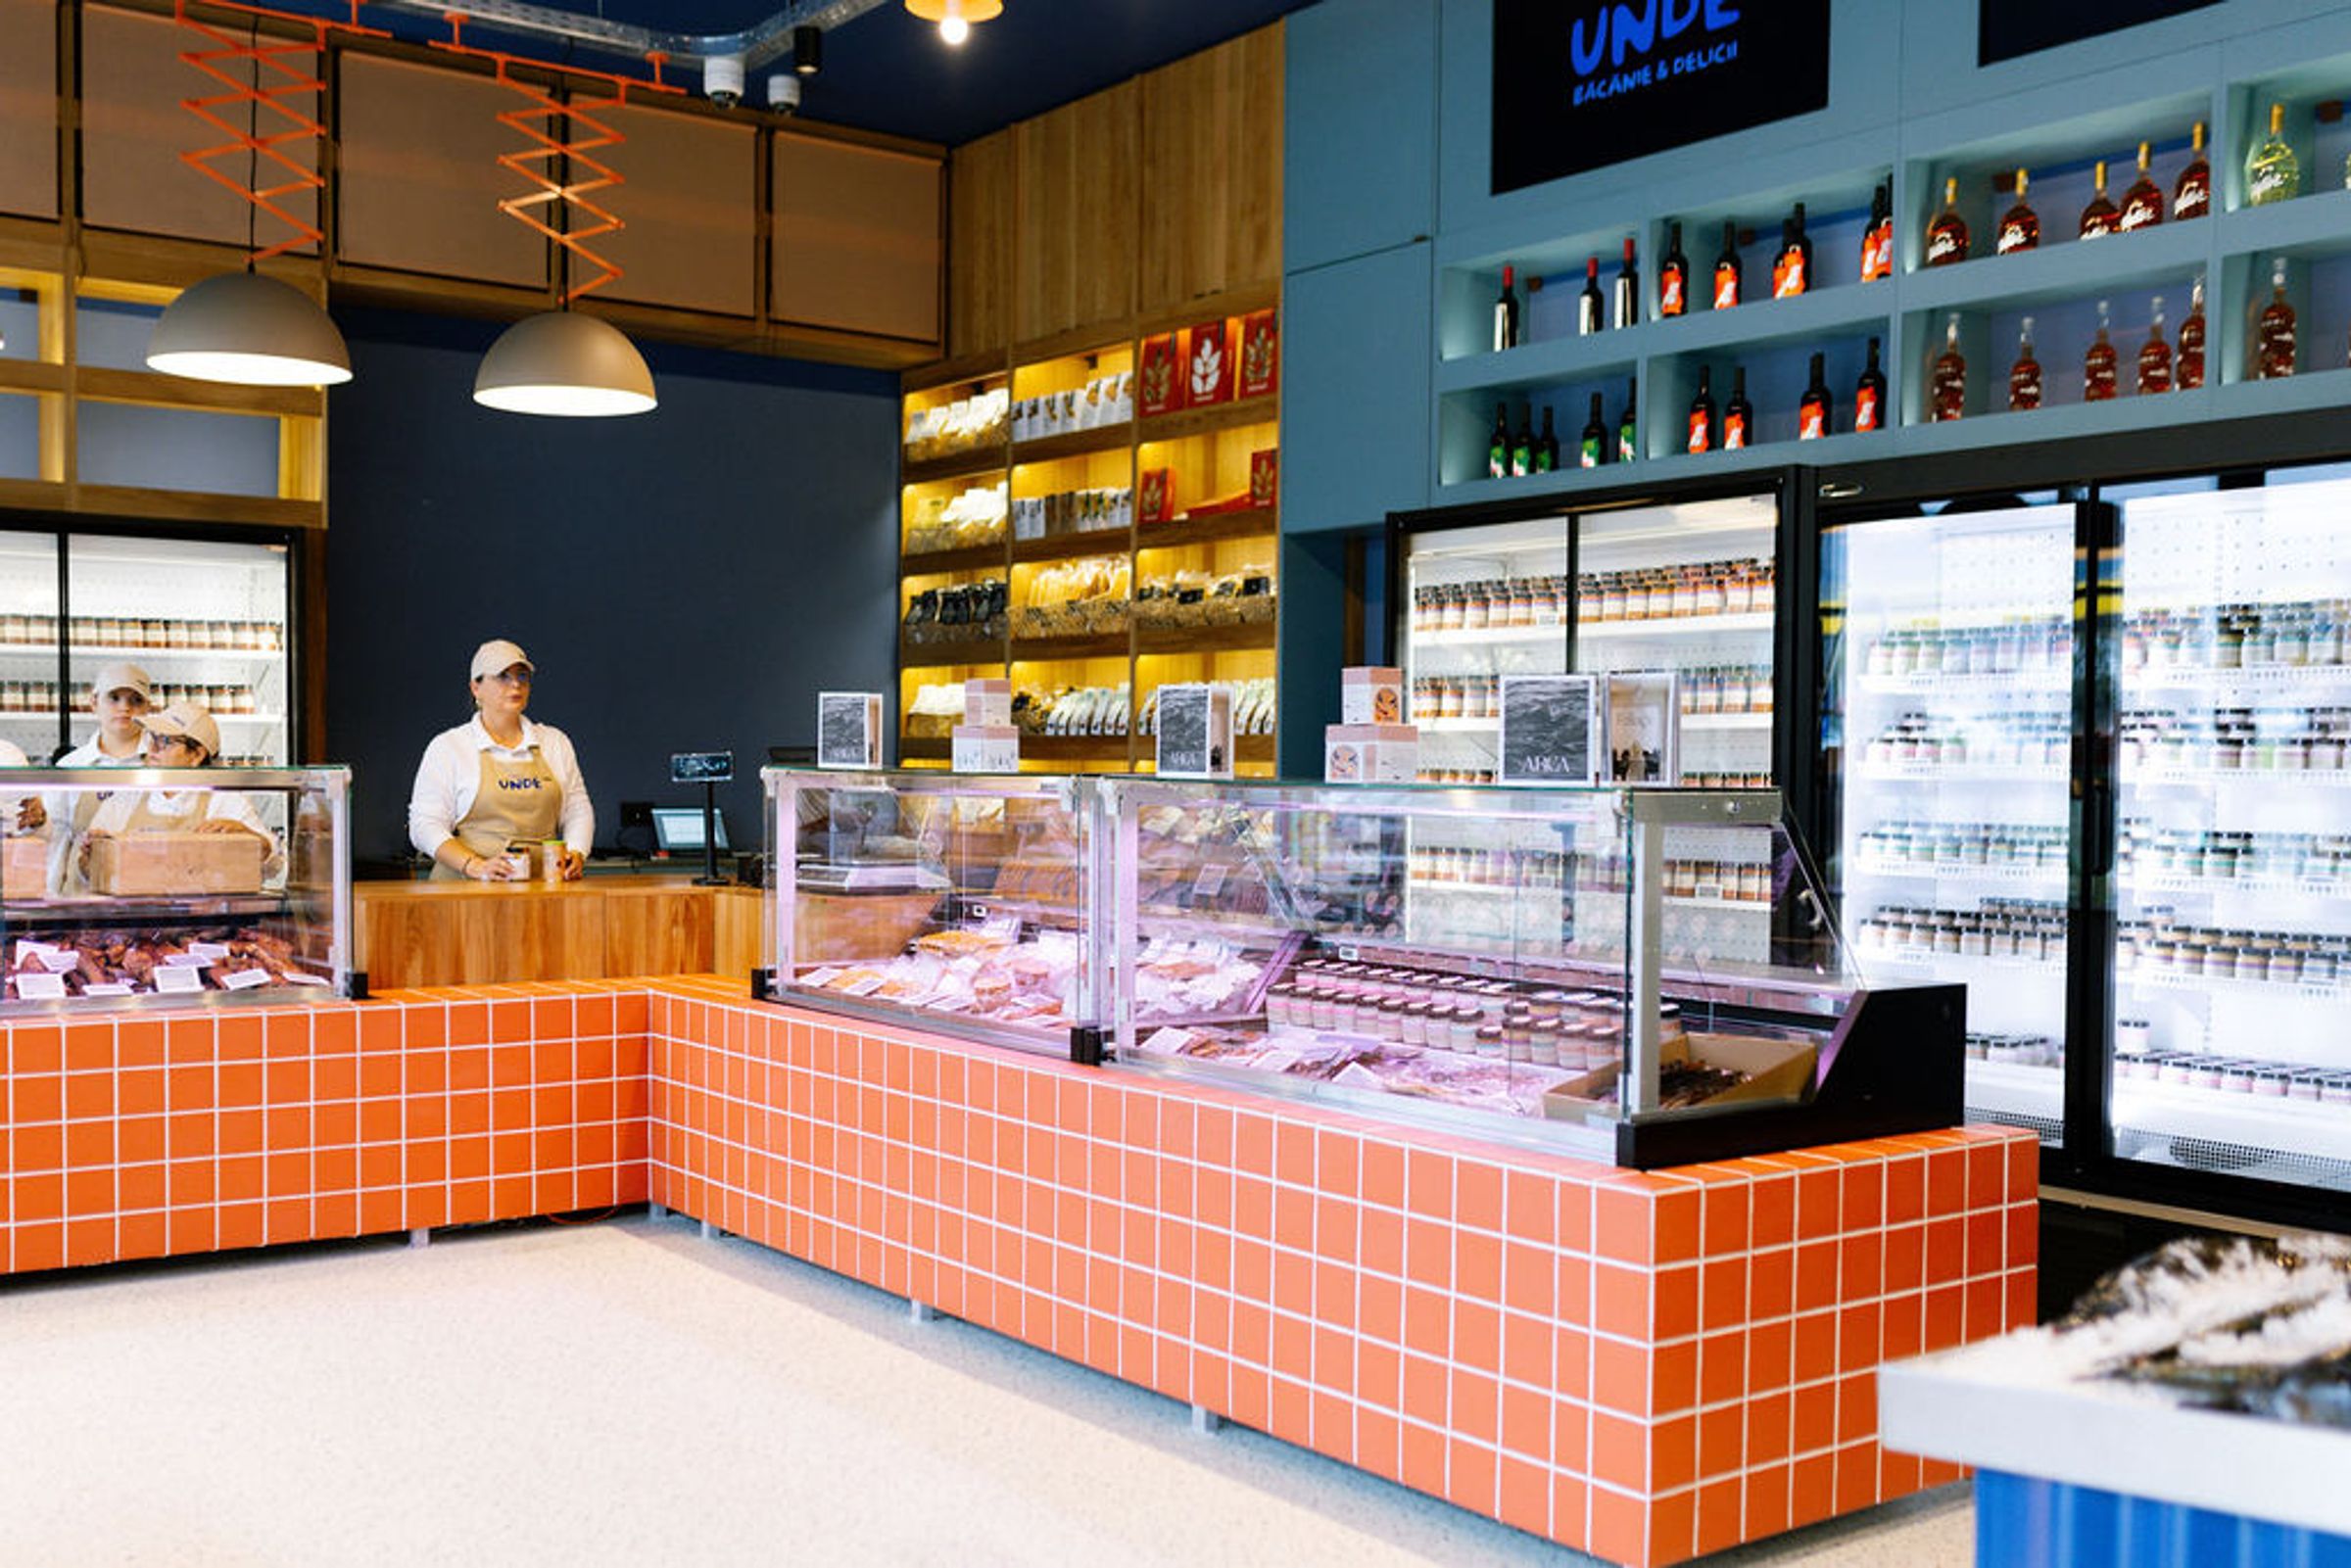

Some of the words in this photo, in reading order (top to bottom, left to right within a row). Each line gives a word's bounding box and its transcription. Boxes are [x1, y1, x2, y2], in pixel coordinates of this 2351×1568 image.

[1570, 0, 1740, 76] UNDE
[1655, 59, 1669, 80] &
[1673, 40, 1738, 75] DELICII
[498, 777, 542, 790] UNDE
